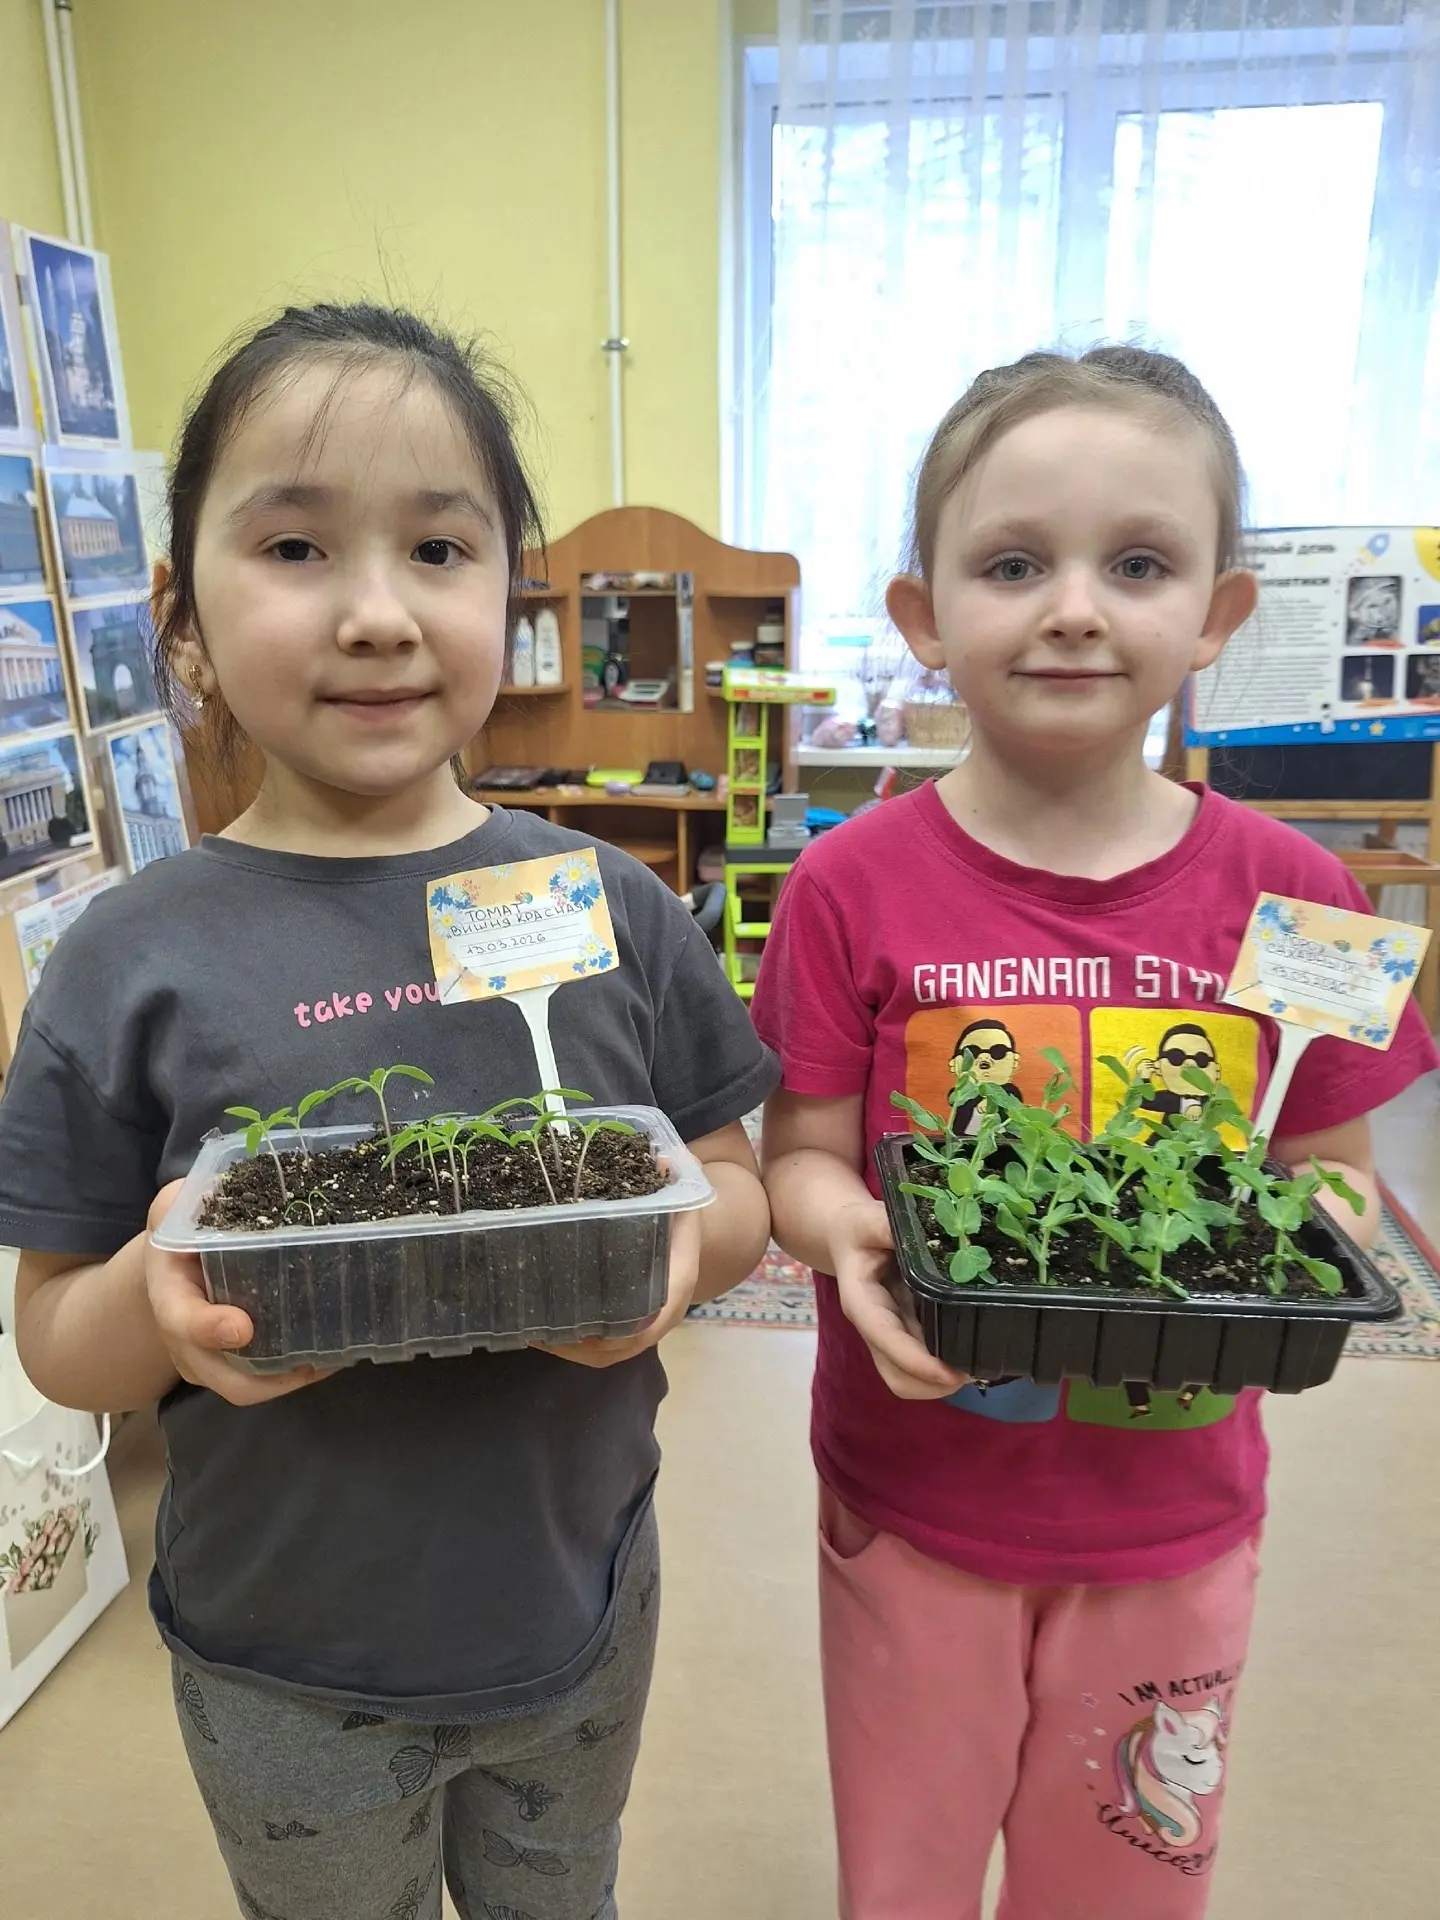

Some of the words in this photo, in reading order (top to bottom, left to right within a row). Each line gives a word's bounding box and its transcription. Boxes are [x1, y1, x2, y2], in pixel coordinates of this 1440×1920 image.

[465, 902, 521, 922] ТОМАТ
[914, 956, 1111, 1003] GANGNAM
[294, 991, 373, 1028] take
[1117, 1692, 1136, 1706] I
[1133, 1681, 1163, 1702] AM
